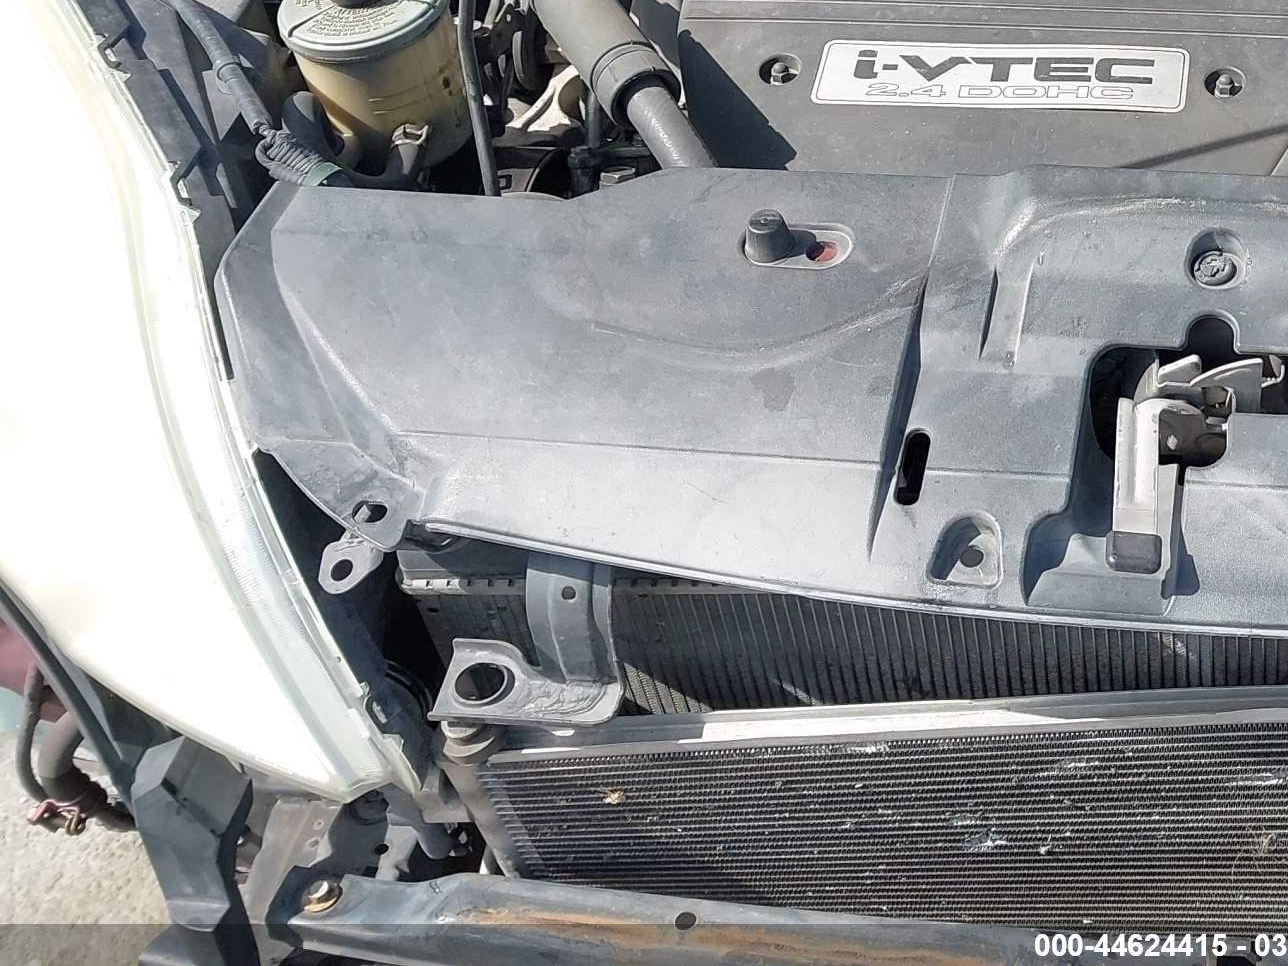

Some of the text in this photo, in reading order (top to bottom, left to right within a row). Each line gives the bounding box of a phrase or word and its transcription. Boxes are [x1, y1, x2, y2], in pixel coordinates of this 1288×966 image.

[853, 49, 1155, 85] i-VTEC
[865, 82, 1134, 100] 2.4 DOHC
